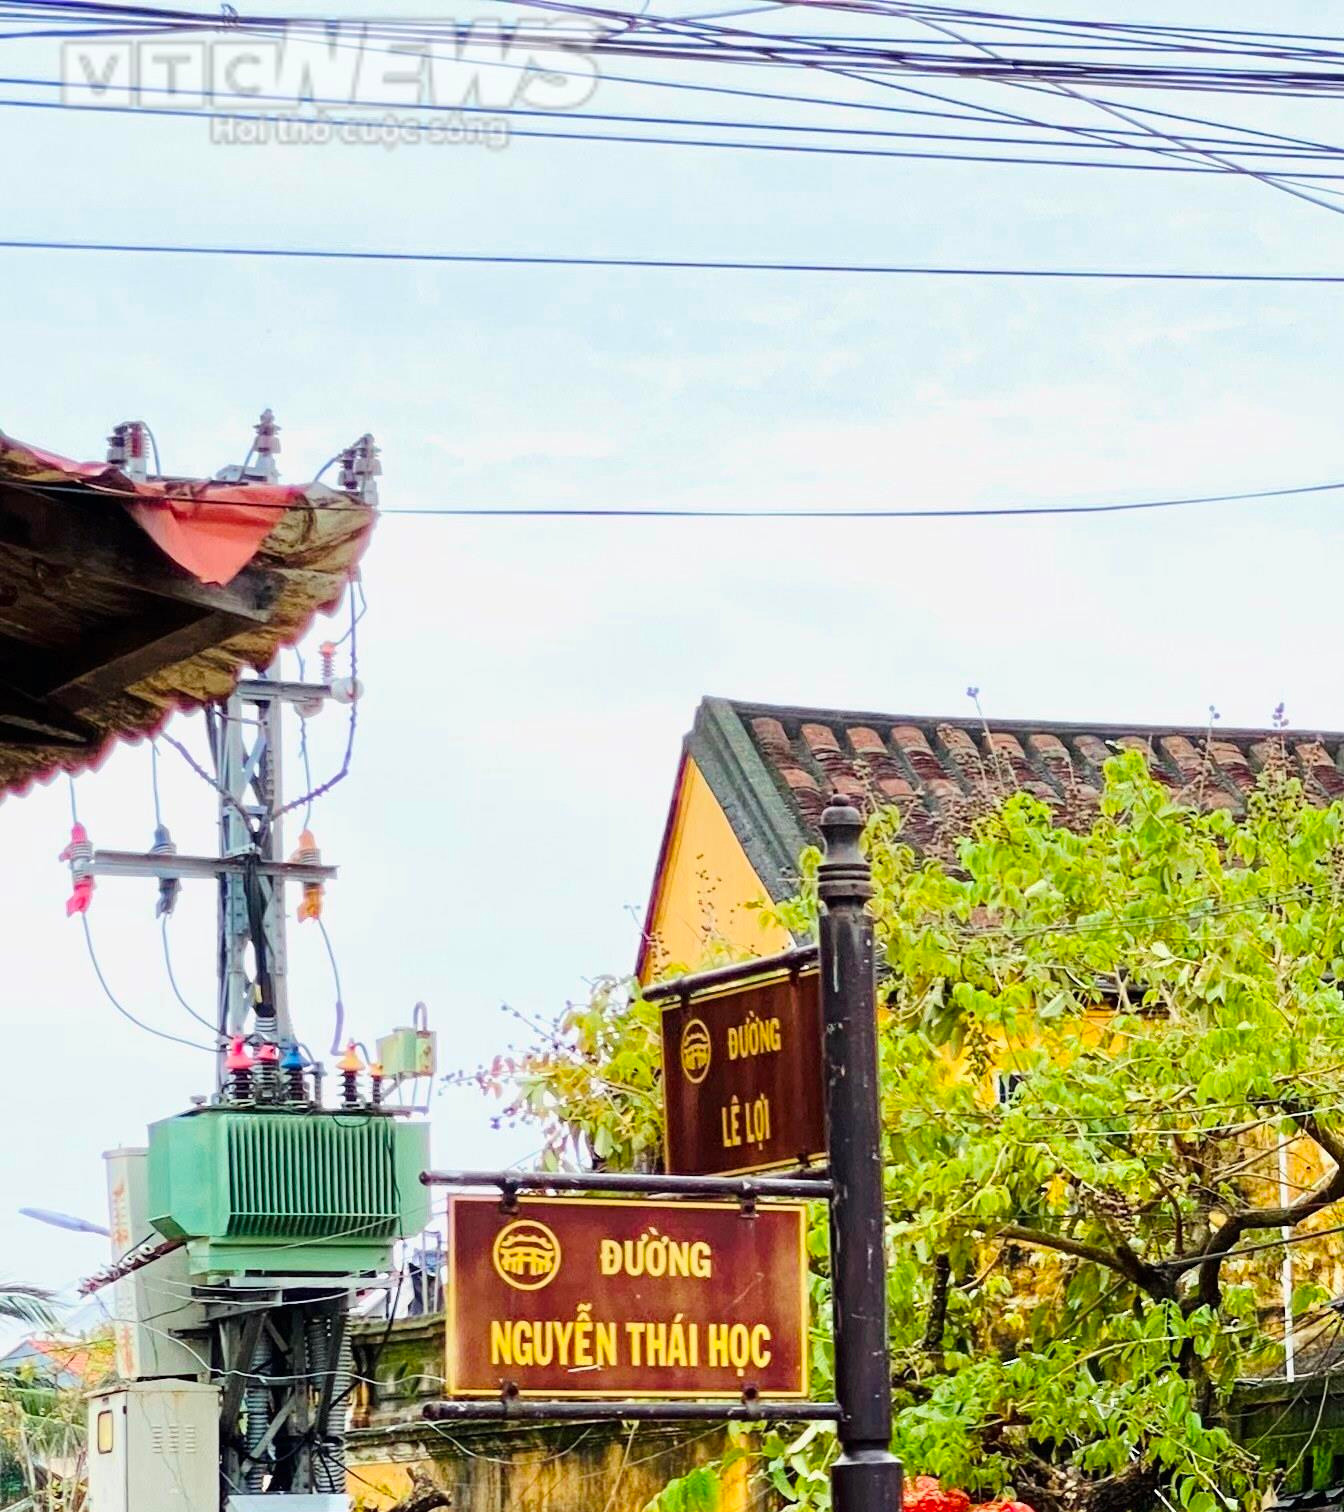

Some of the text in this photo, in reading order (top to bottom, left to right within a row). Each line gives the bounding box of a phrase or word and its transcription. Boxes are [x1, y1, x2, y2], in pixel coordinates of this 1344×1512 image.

[727, 1010, 782, 1061] ĐƯỜNG
[721, 1093, 771, 1151] LÊ LỢI
[600, 1226, 712, 1278] ĐƯỜNG
[490, 1302, 772, 1377] NGUYỄN THÁI HỌC
